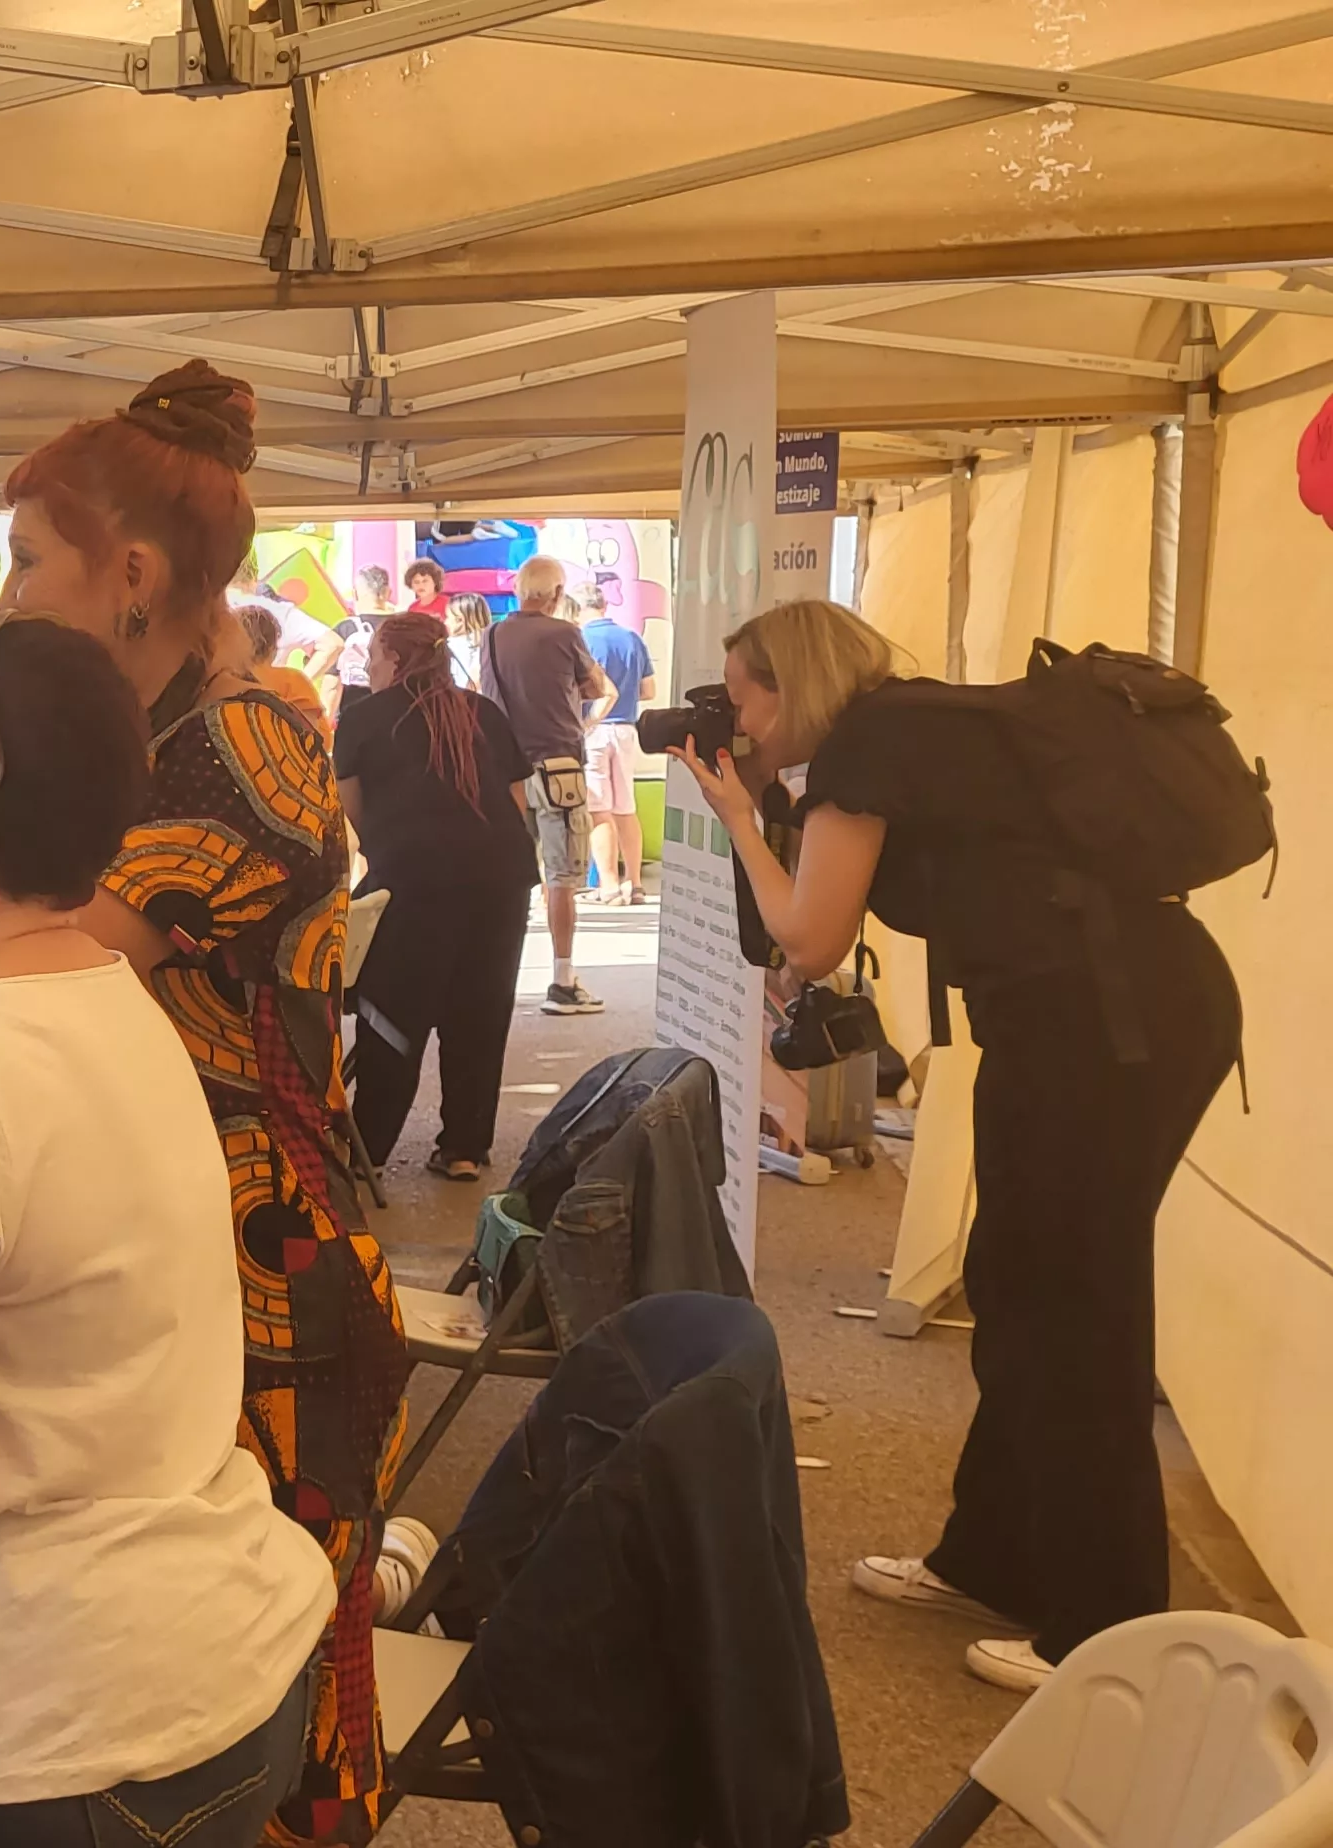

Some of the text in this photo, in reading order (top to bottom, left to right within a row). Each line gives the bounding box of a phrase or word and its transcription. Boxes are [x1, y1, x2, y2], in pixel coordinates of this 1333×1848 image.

[785, 451, 828, 473] Mundo,
[776, 483, 820, 507] estizaje
[773, 541, 817, 571] ación
